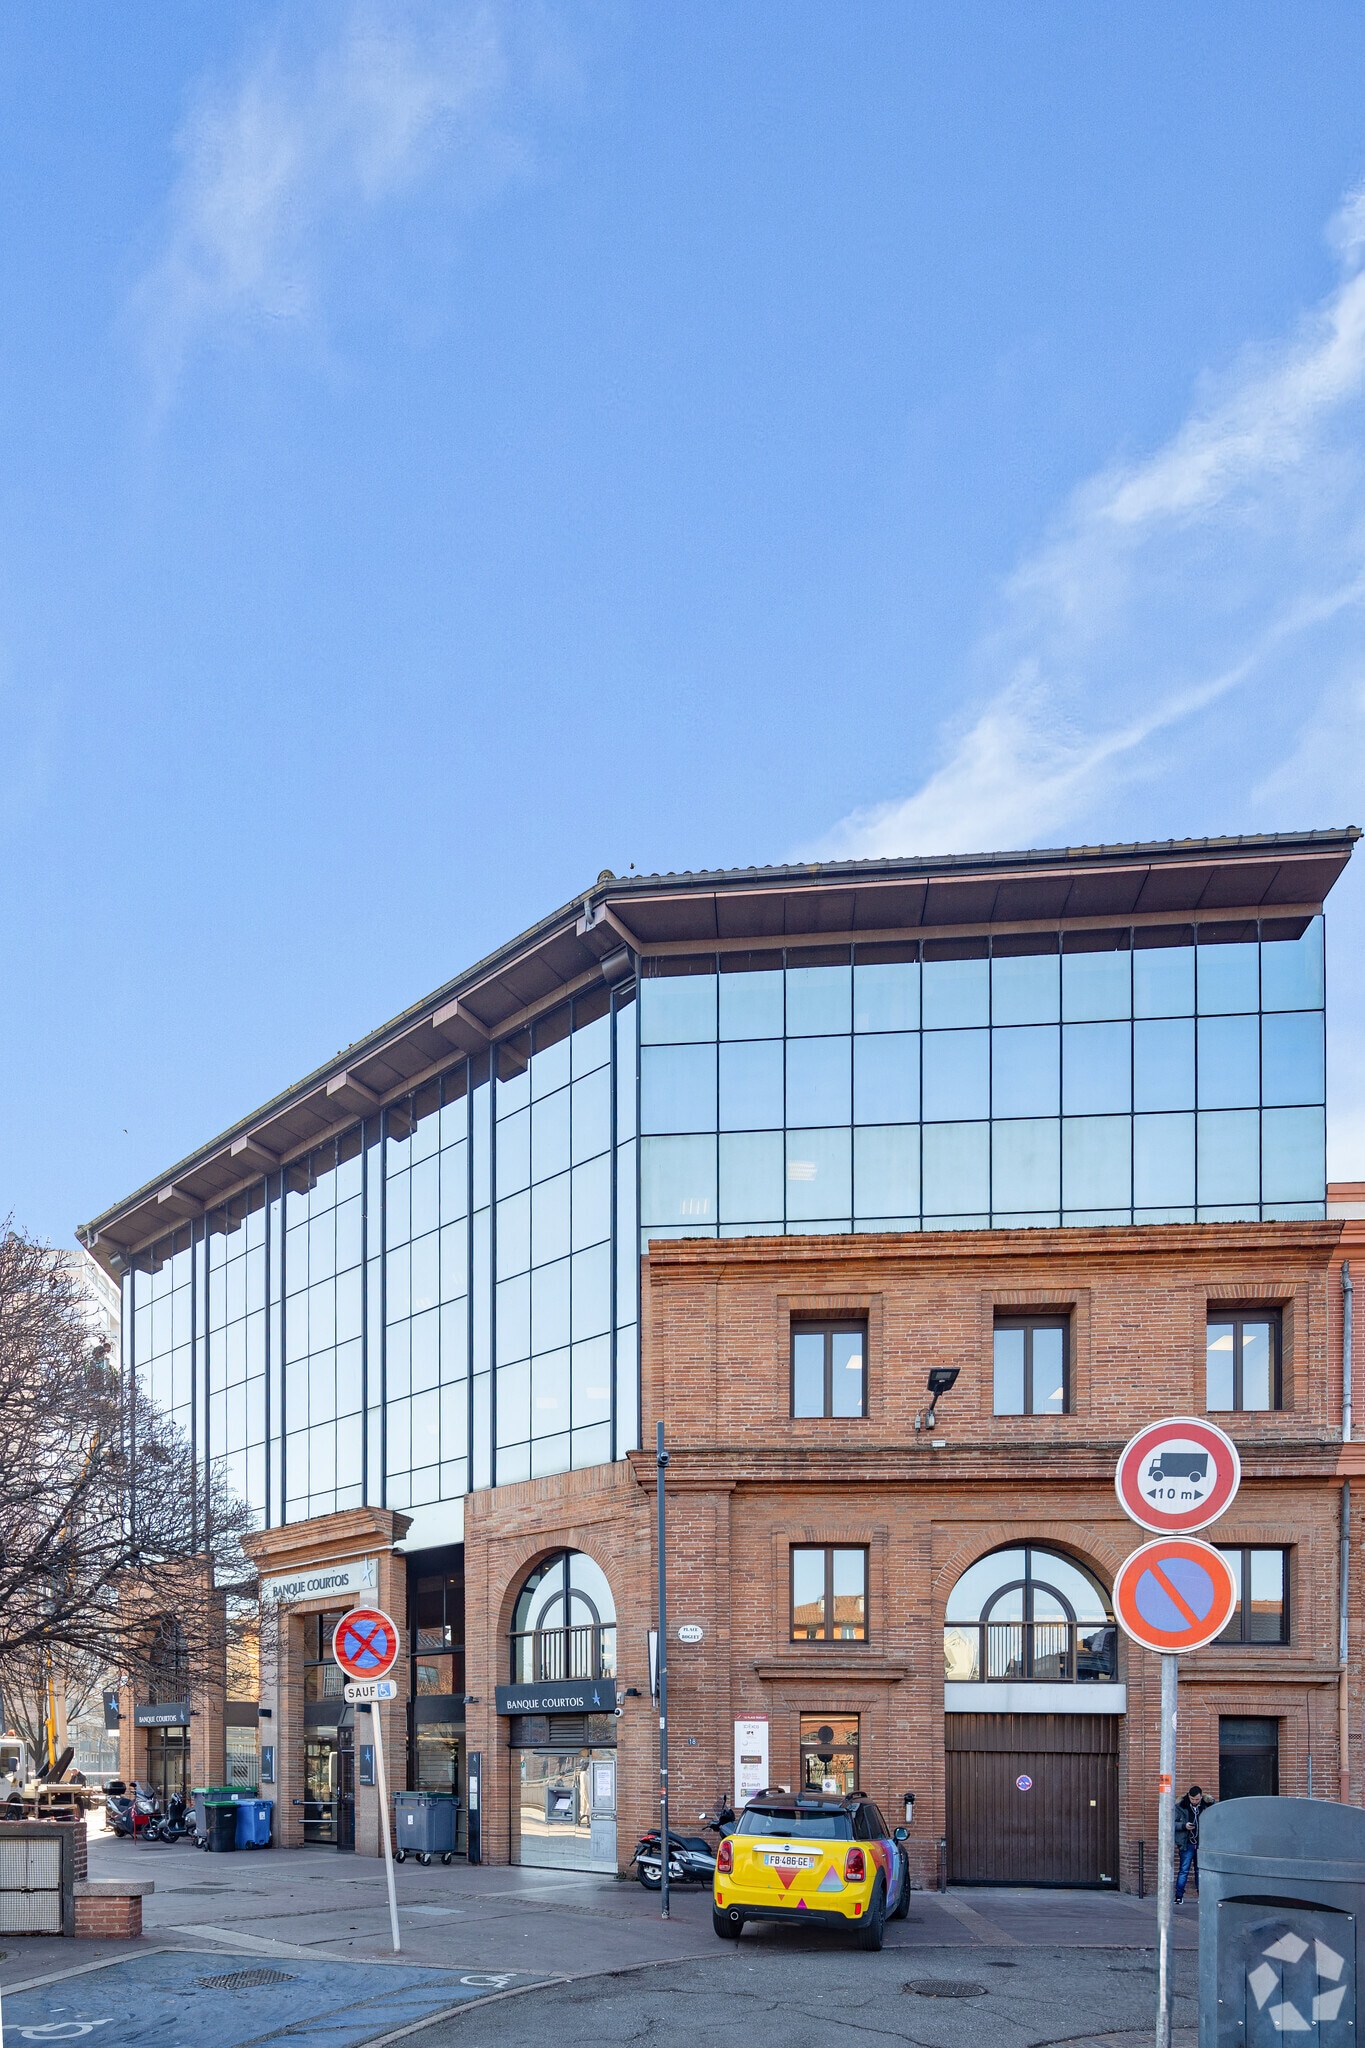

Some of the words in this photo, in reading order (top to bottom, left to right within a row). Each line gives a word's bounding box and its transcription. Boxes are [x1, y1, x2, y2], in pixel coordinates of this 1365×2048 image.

[1158, 1488, 1176, 1499] 10
[1180, 1491, 1192, 1500] m
[273, 1581, 305, 1597] BANQUE
[307, 1573, 349, 1592] COURTOIS
[348, 1686, 375, 1698] SAUF
[506, 1699, 539, 1710] BANQUE
[541, 1696, 584, 1708] COURTOIS
[156, 1714, 177, 1722] COURTOIS
